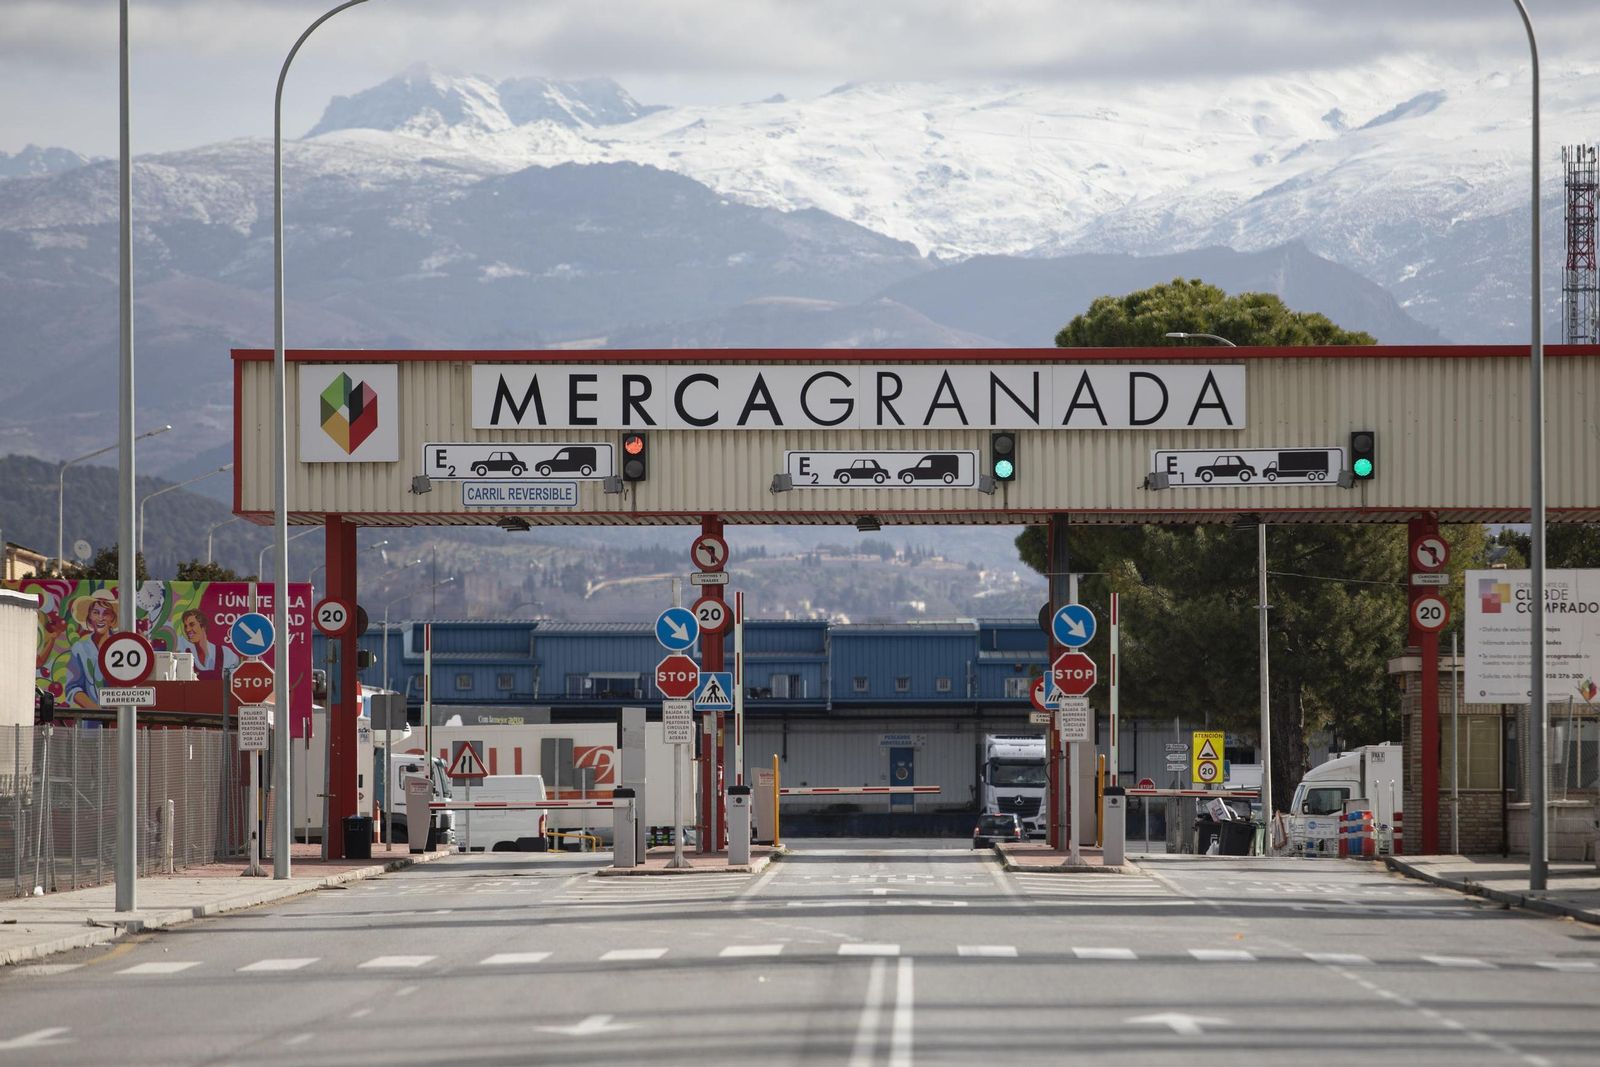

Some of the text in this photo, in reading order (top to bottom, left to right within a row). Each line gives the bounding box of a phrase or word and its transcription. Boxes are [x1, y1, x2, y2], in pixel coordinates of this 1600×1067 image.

[490, 369, 1233, 426] MERCAGRANADA
[467, 486, 572, 501] CARRIL REVERSIBLE
[322, 610, 344, 623] 20
[700, 608, 722, 621] 20
[1420, 607, 1441, 620] 20
[110, 650, 141, 668] 20
[658, 671, 697, 682] STOP
[1055, 669, 1094, 680] STOP
[233, 677, 272, 688] STOP
